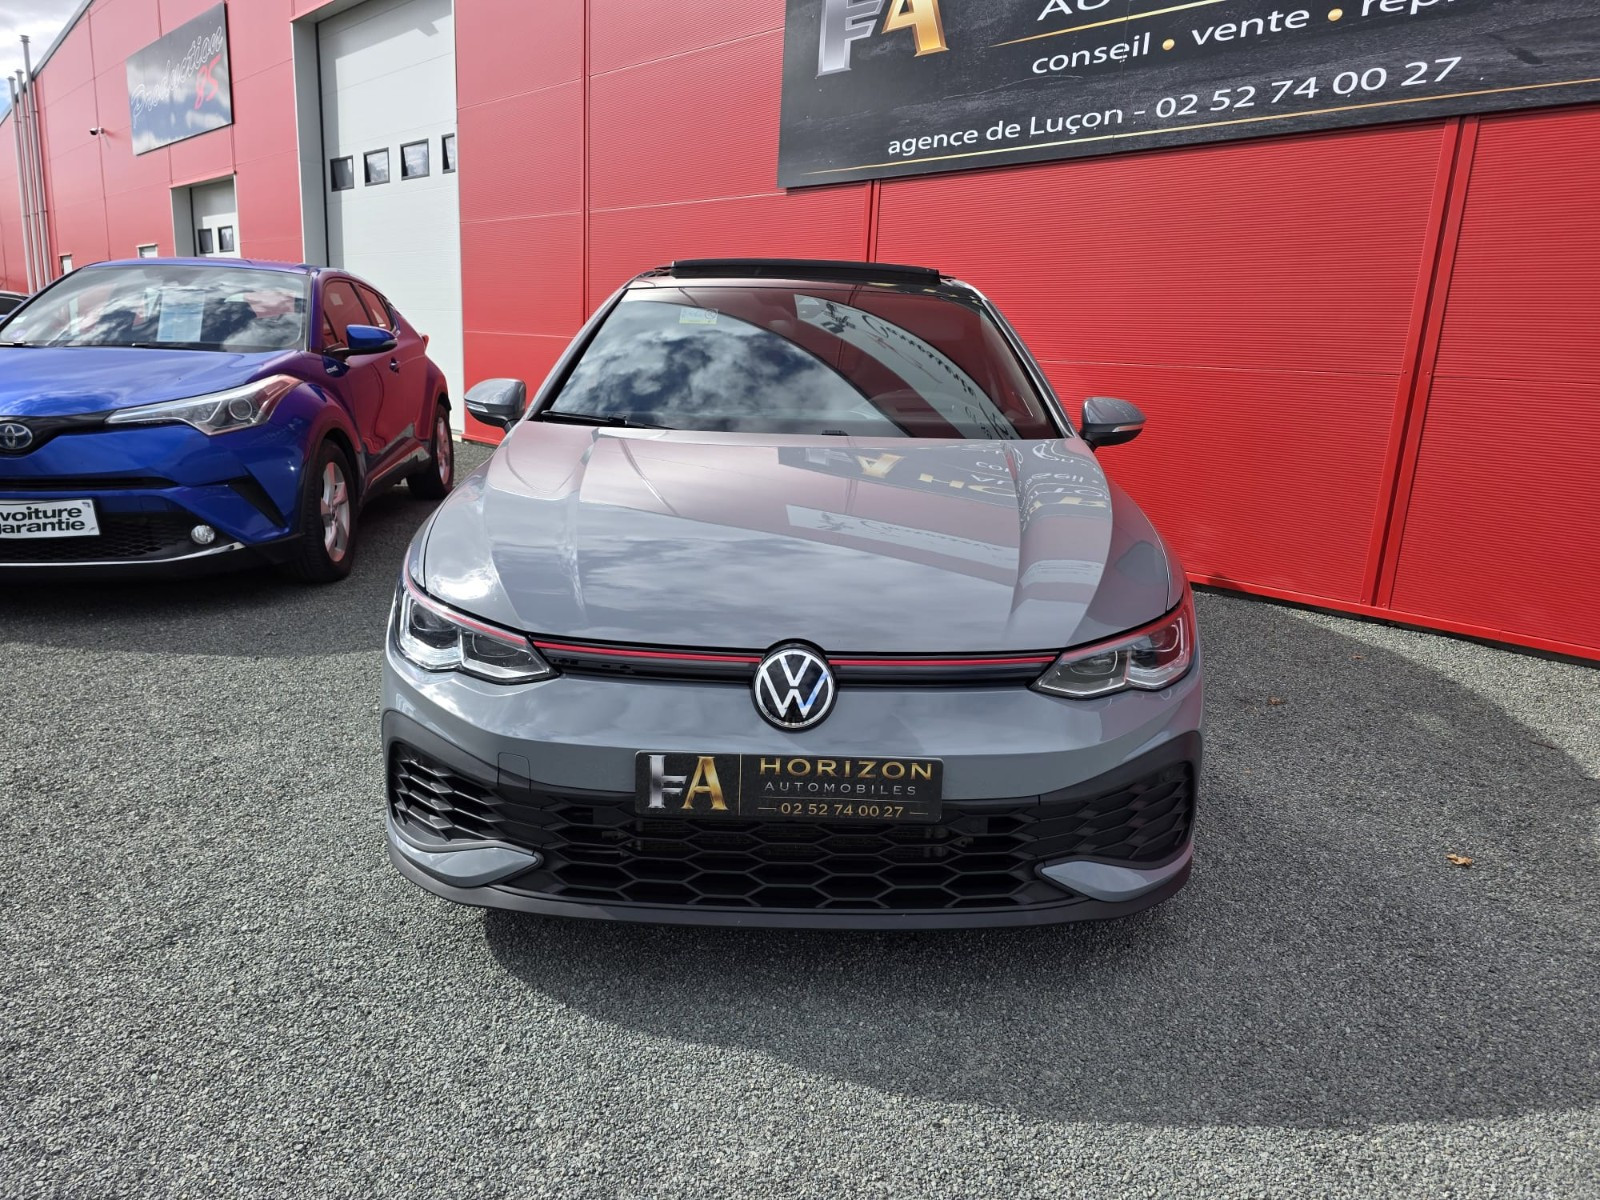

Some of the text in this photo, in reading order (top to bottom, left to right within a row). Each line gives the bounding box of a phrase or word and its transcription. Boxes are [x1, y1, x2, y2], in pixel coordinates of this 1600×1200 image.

[1032, 32, 1151, 74] conseil
[1191, 10, 1310, 46] vente
[888, 129, 979, 156] agence
[985, 120, 1021, 141] de
[1030, 108, 1123, 136] Luçon
[1156, 94, 1198, 118] 02
[1209, 86, 1256, 112] 52
[1271, 76, 1320, 104] 74
[1332, 67, 1388, 95] 00
[1400, 56, 1463, 87] 27
[0, 506, 83, 521] voiture
[0, 518, 86, 534] arantie
[759, 757, 933, 781] HORIZON
[764, 782, 916, 796] AUTOMOBILES
[781, 802, 904, 819] 02 52 74 00 27
